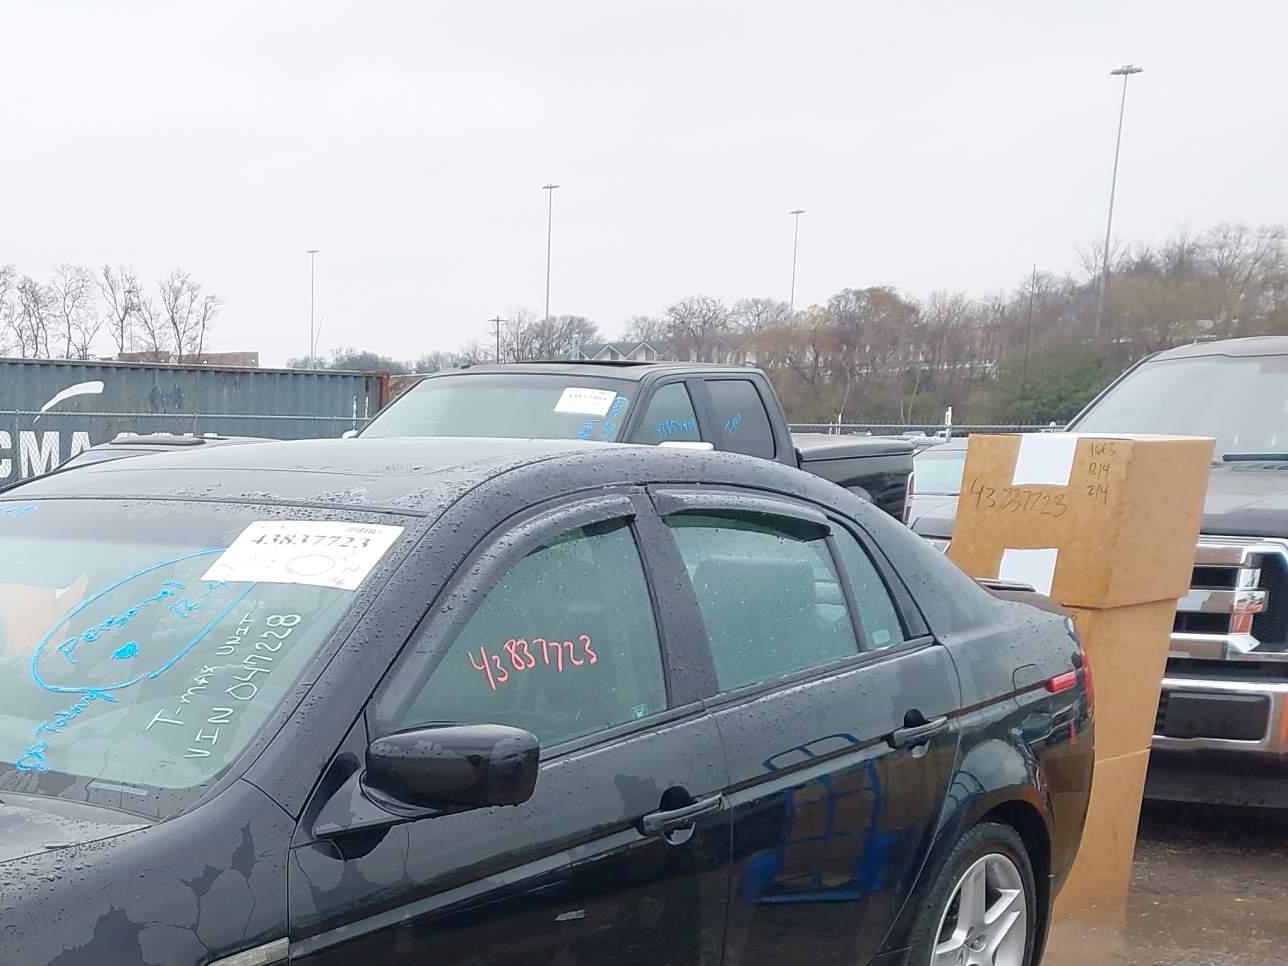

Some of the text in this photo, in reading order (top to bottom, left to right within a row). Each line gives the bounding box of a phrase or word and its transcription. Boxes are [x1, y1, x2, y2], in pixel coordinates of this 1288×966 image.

[250, 533, 373, 549] 43837723
[183, 614, 302, 759] VIN 047228
[468, 634, 598, 692] 43837723
